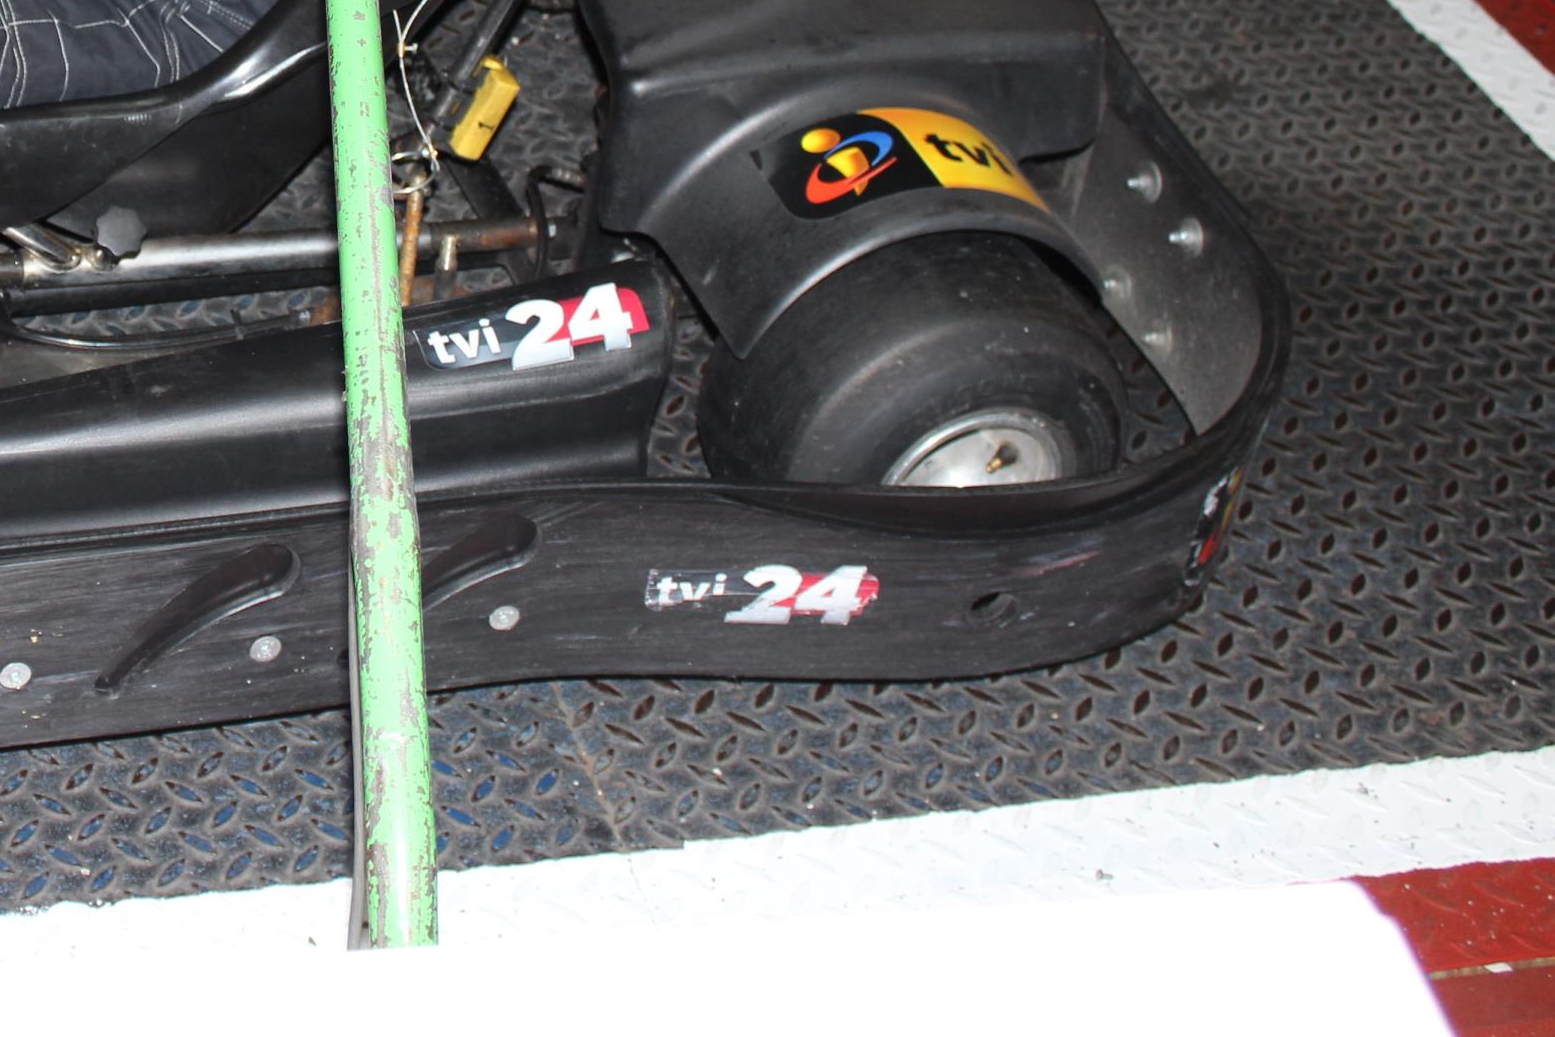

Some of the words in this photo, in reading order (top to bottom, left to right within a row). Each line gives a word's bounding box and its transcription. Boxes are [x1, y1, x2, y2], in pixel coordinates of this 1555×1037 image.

[924, 133, 1015, 178] tvi
[427, 317, 502, 365] tvi
[505, 282, 634, 371] 24
[656, 573, 728, 606] tvi
[724, 564, 868, 626] 24
